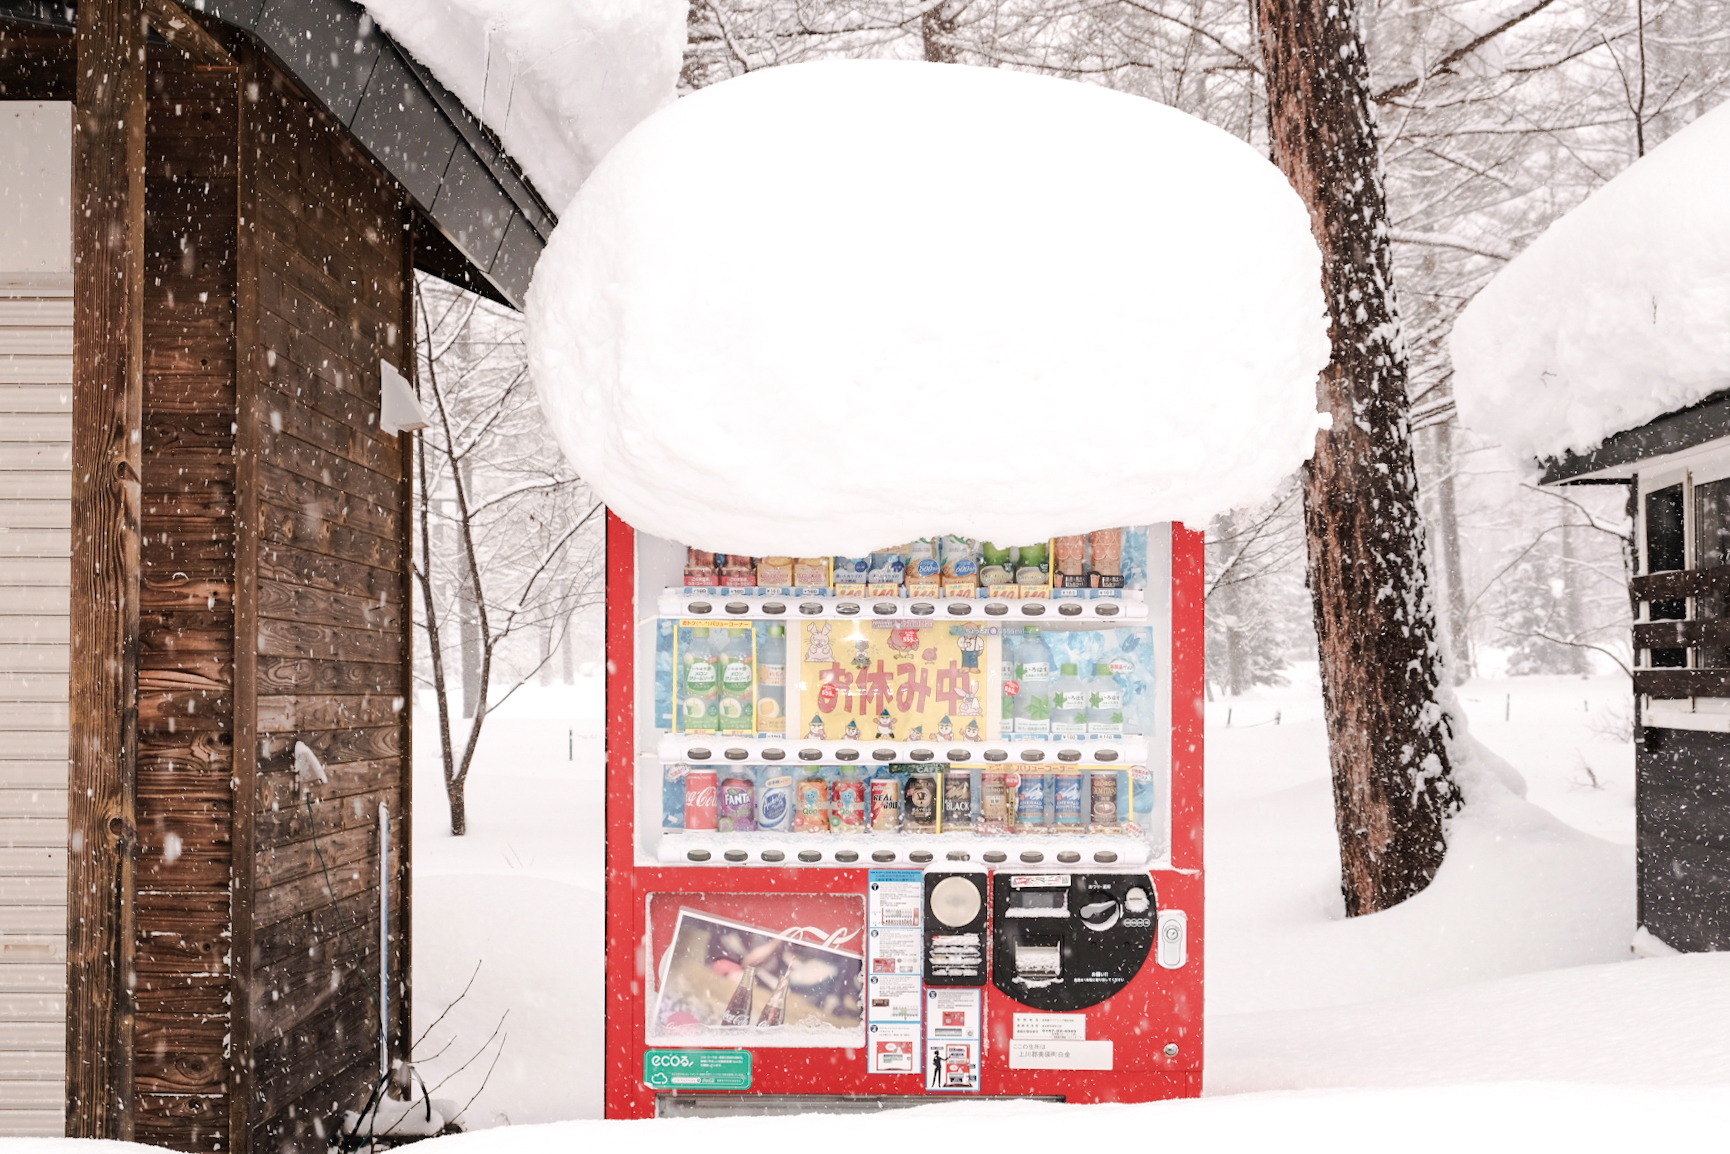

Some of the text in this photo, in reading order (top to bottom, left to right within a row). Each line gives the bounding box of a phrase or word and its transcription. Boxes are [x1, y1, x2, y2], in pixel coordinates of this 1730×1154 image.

[818, 660, 970, 716] お休み中
[802, 807, 818, 815] Qoo
[946, 801, 970, 811] BLACK
